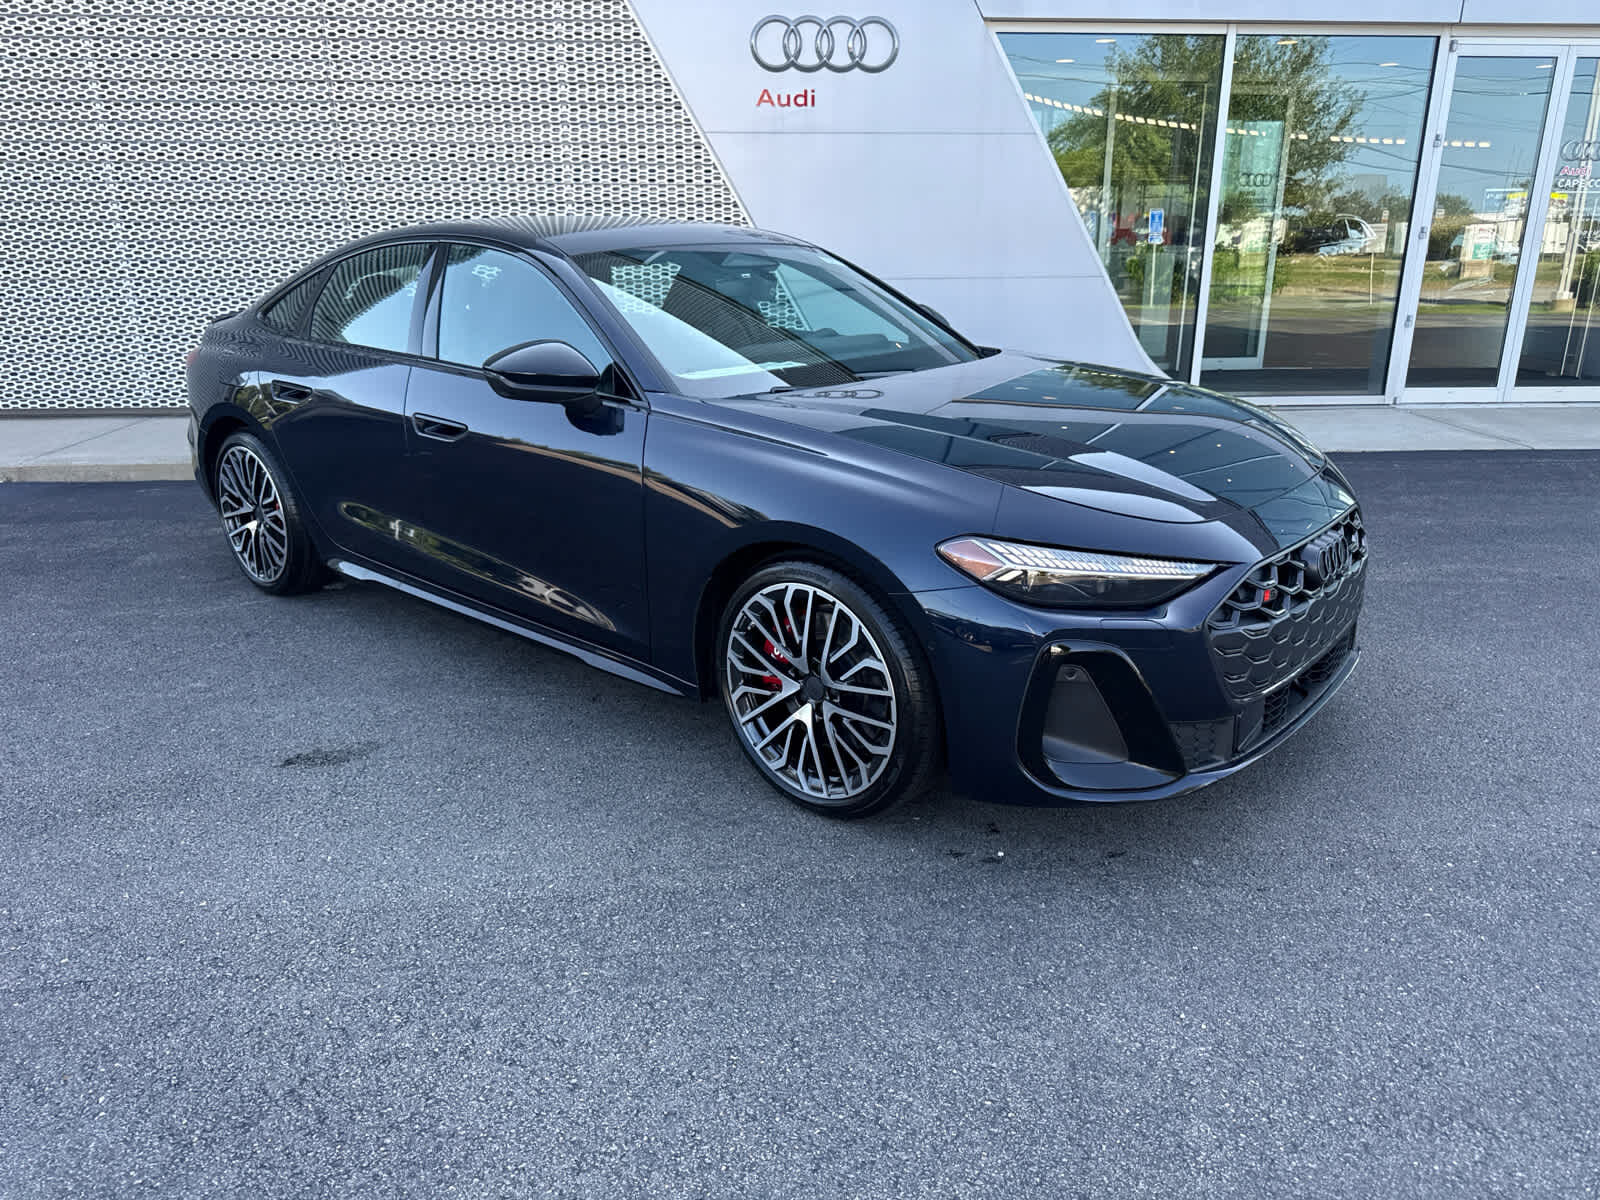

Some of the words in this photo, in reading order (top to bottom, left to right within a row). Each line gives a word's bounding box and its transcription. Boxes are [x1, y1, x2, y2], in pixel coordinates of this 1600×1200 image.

[756, 88, 816, 108] Audi
[1559, 165, 1591, 176] Audi
[1558, 178, 1586, 188] CAPE
